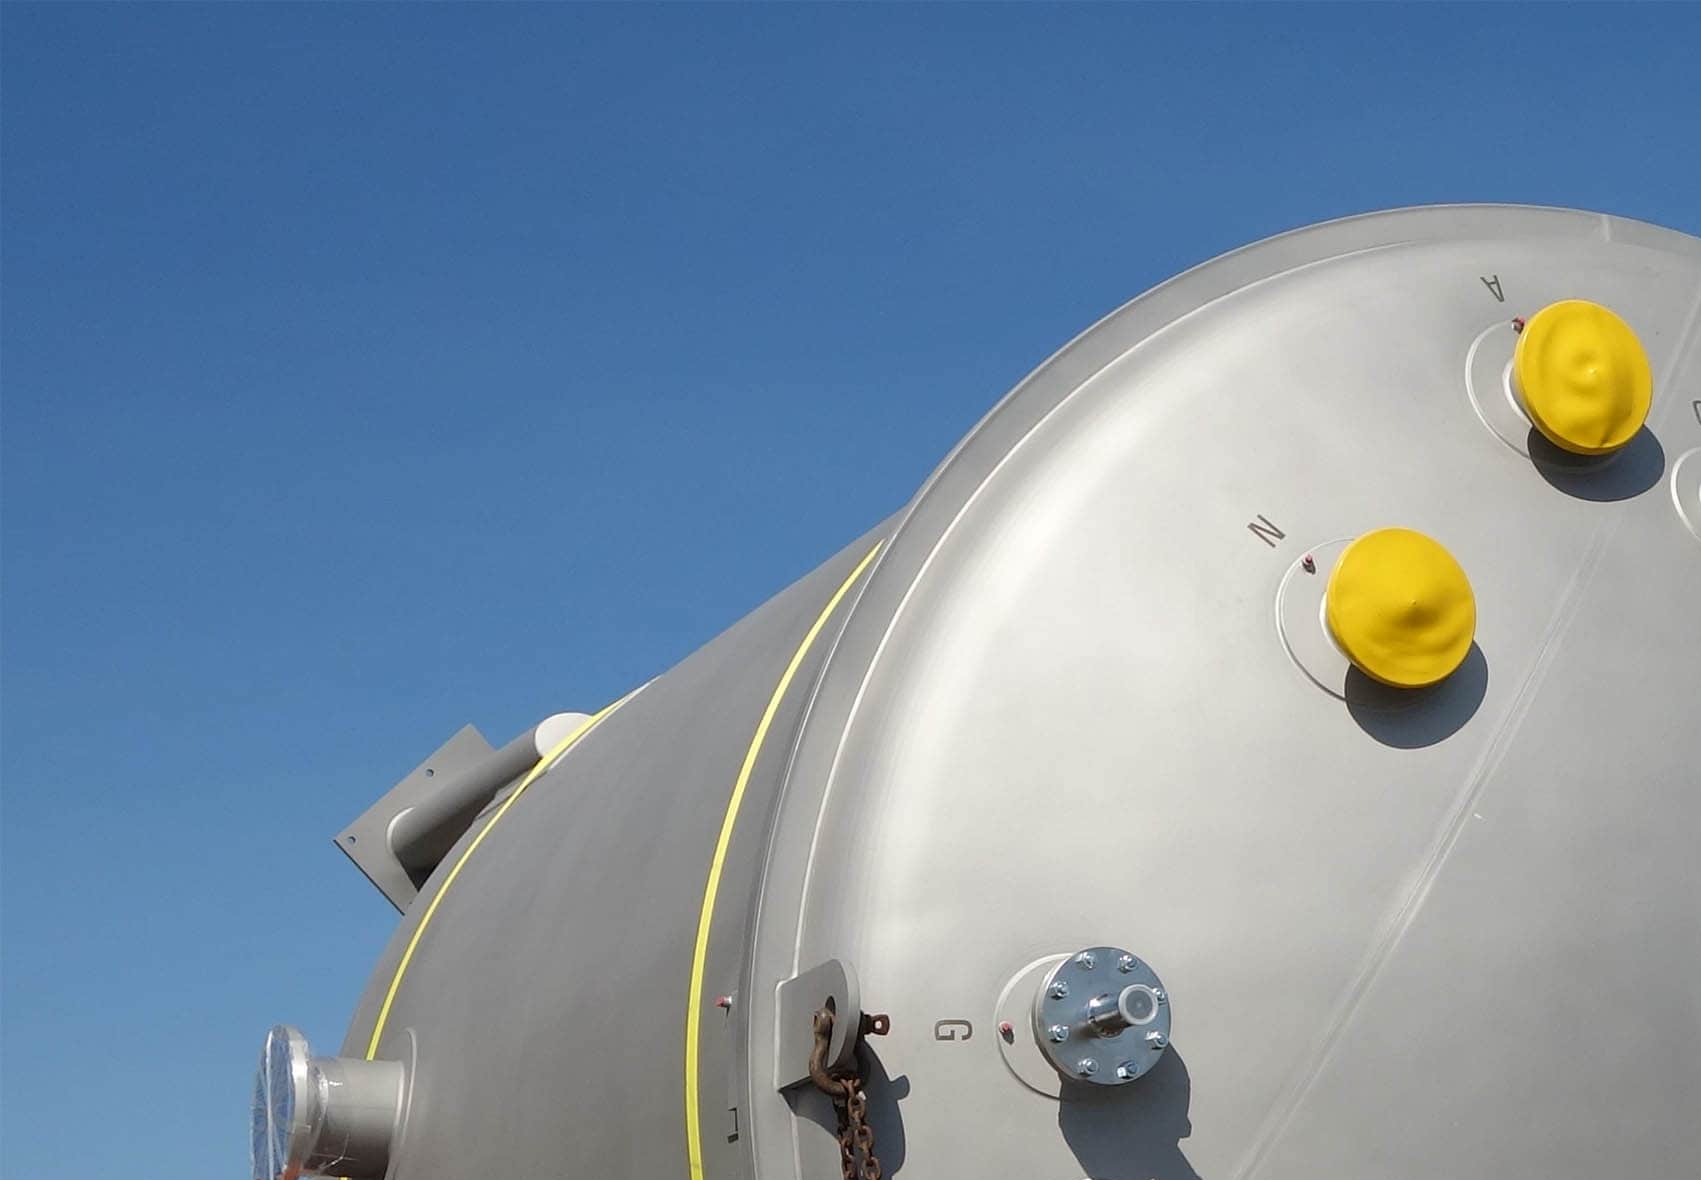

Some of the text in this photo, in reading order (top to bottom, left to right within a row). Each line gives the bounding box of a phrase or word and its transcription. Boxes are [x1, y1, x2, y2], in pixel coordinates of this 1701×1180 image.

[1480, 274, 1505, 302] A
[1247, 514, 1286, 548] N
[934, 1019, 973, 1041] G
